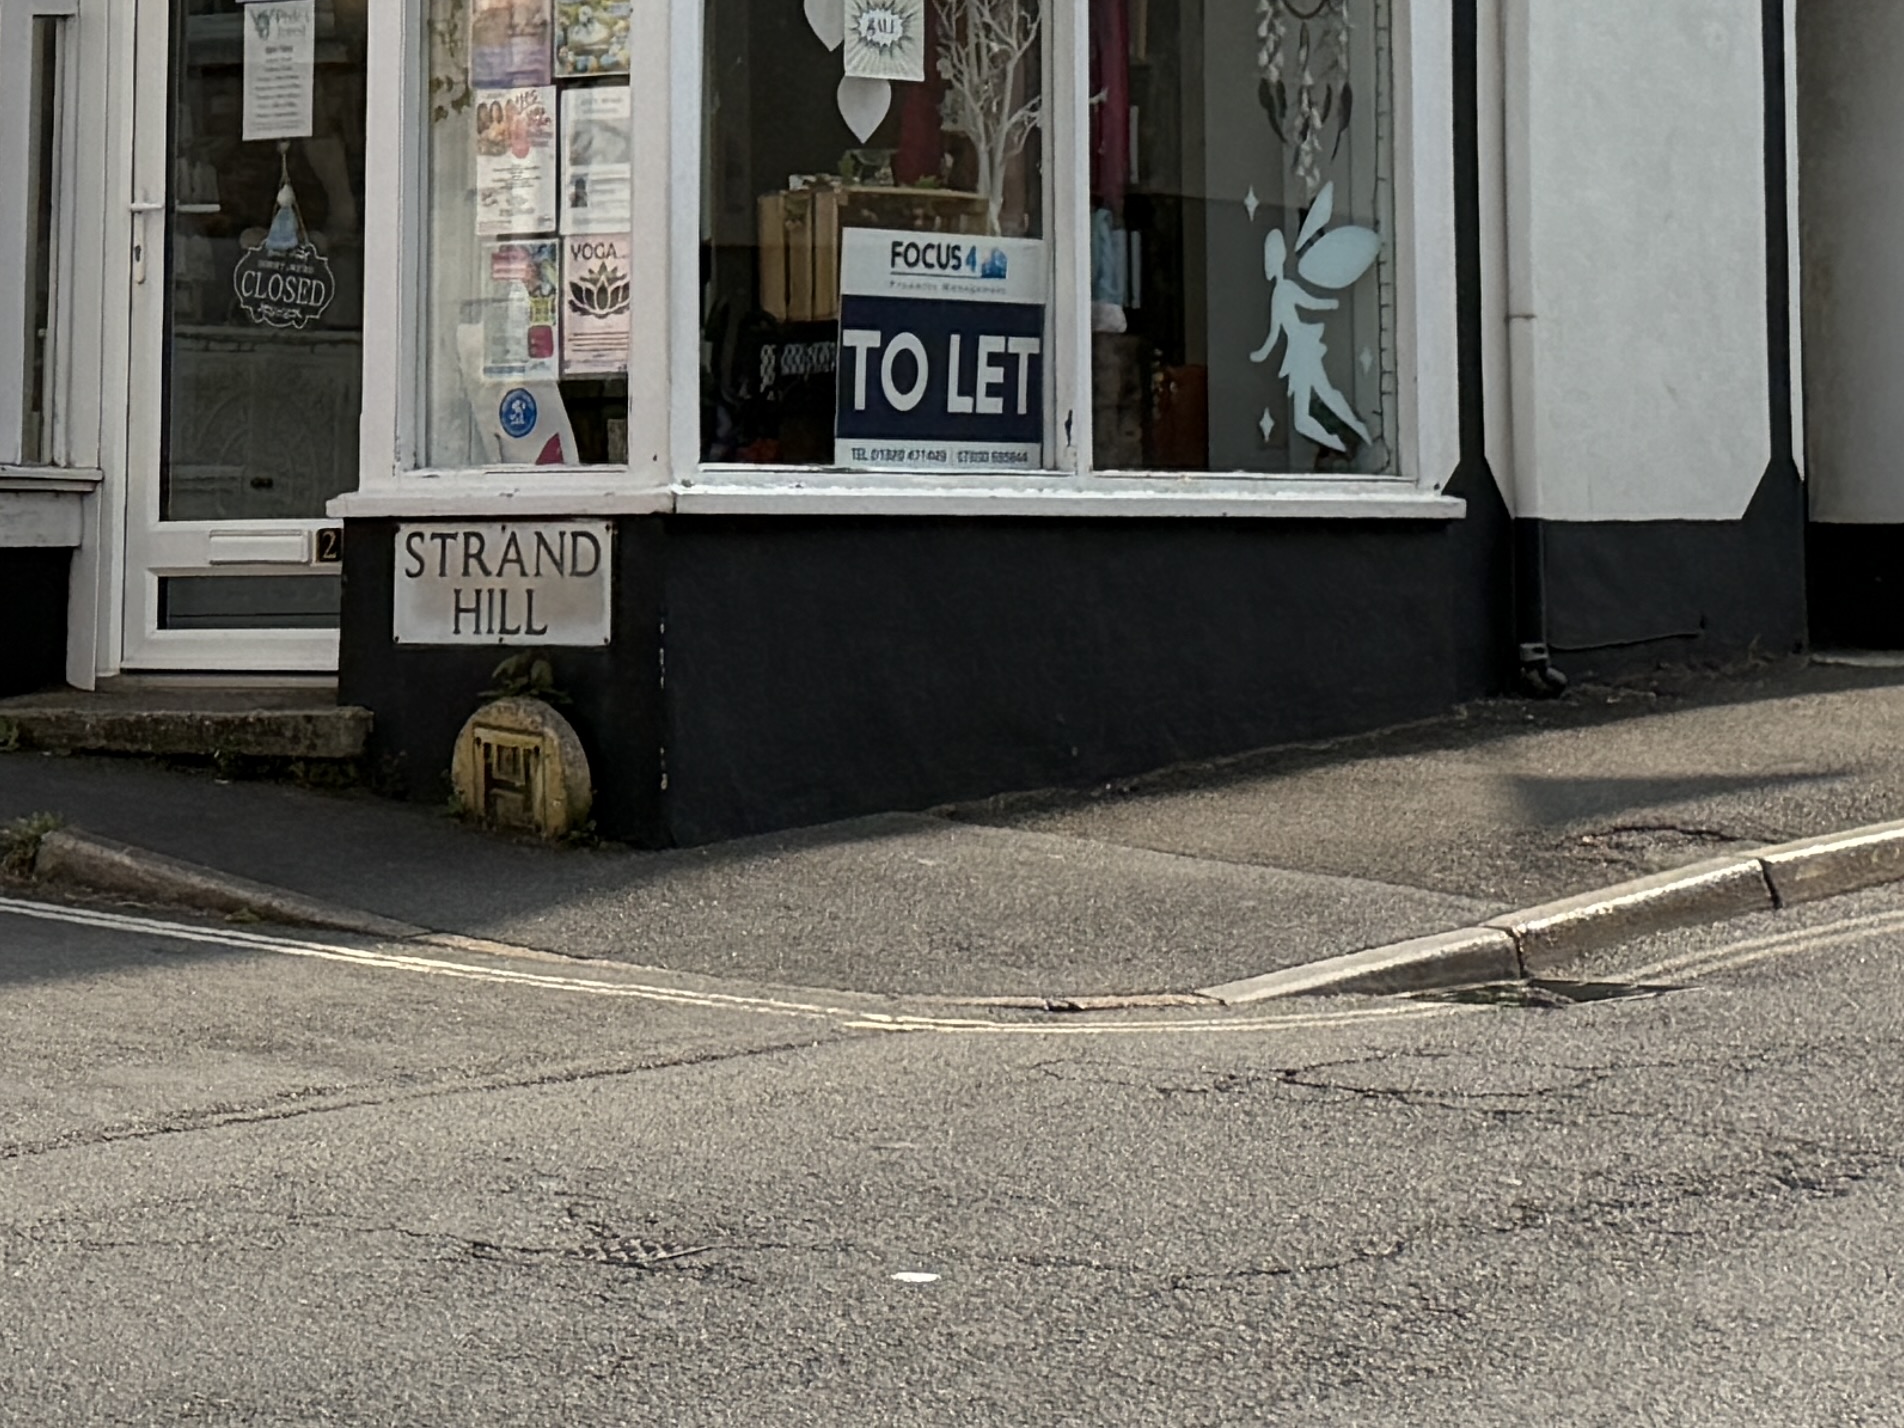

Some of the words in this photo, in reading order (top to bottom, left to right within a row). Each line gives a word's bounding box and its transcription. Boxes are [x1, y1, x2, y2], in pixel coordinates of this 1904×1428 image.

[890, 240, 962, 272] FOCUS
[965, 244, 978, 273] 4
[241, 270, 326, 307] CLOSED
[842, 328, 930, 413] TO
[947, 333, 1041, 415] LET
[322, 530, 337, 559] 2
[404, 530, 602, 579] STRAND
[452, 588, 549, 636] HILL
